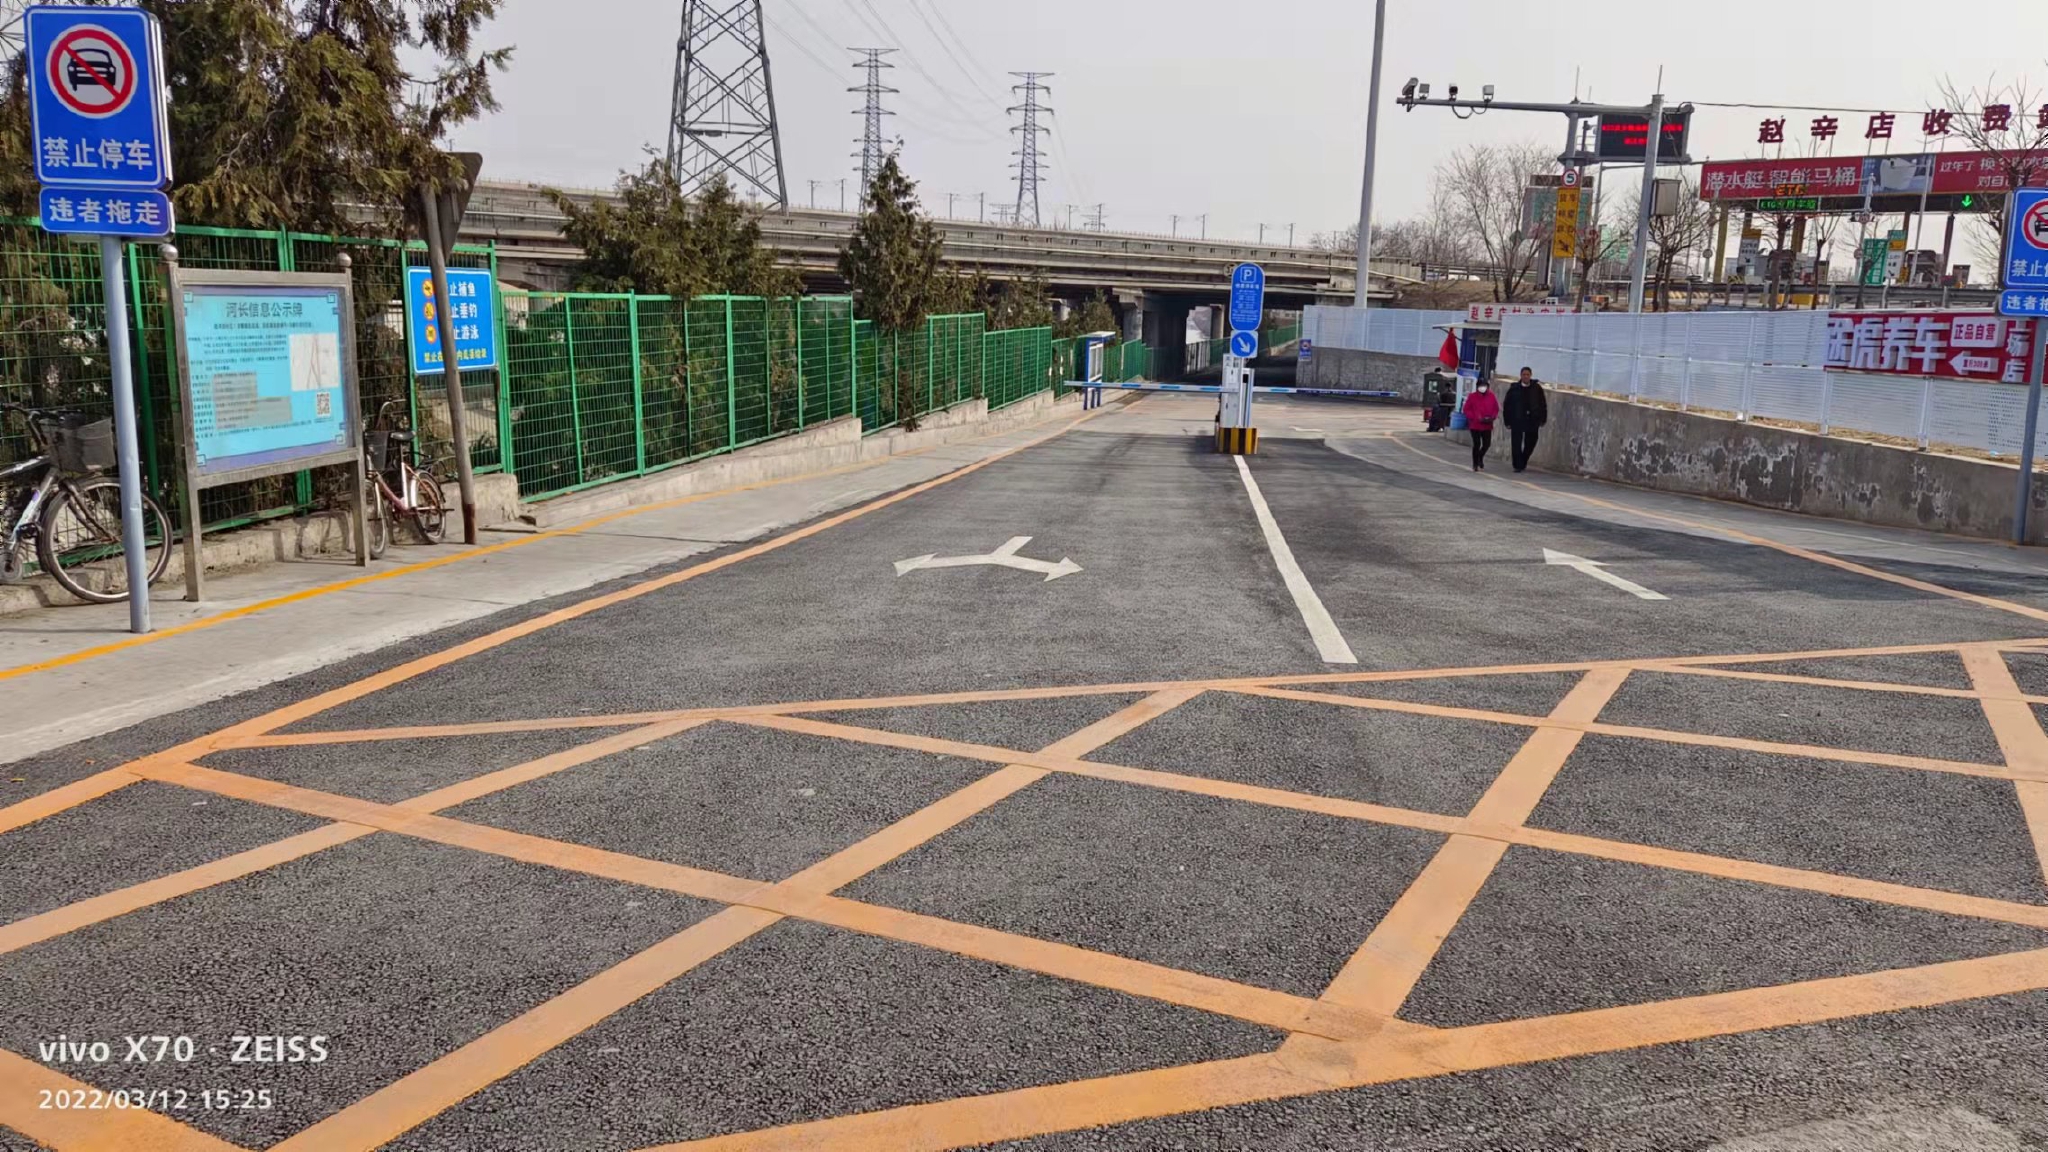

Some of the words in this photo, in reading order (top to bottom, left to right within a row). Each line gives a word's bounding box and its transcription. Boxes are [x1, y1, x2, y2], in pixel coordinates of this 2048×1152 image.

[42, 136, 153, 170] 禁止停车
[1939, 160, 1976, 173] 过年了
[1566, 173, 1575, 184] 5
[49, 197, 161, 225] 违者拖走
[2011, 259, 2048, 277] 禁止
[449, 281, 476, 297] 止捕鱼
[226, 301, 303, 318] 河长信息公示牌
[451, 302, 478, 318] 止垂钓
[453, 324, 479, 340] 止游泳
[1954, 323, 1996, 340] 正品自营
